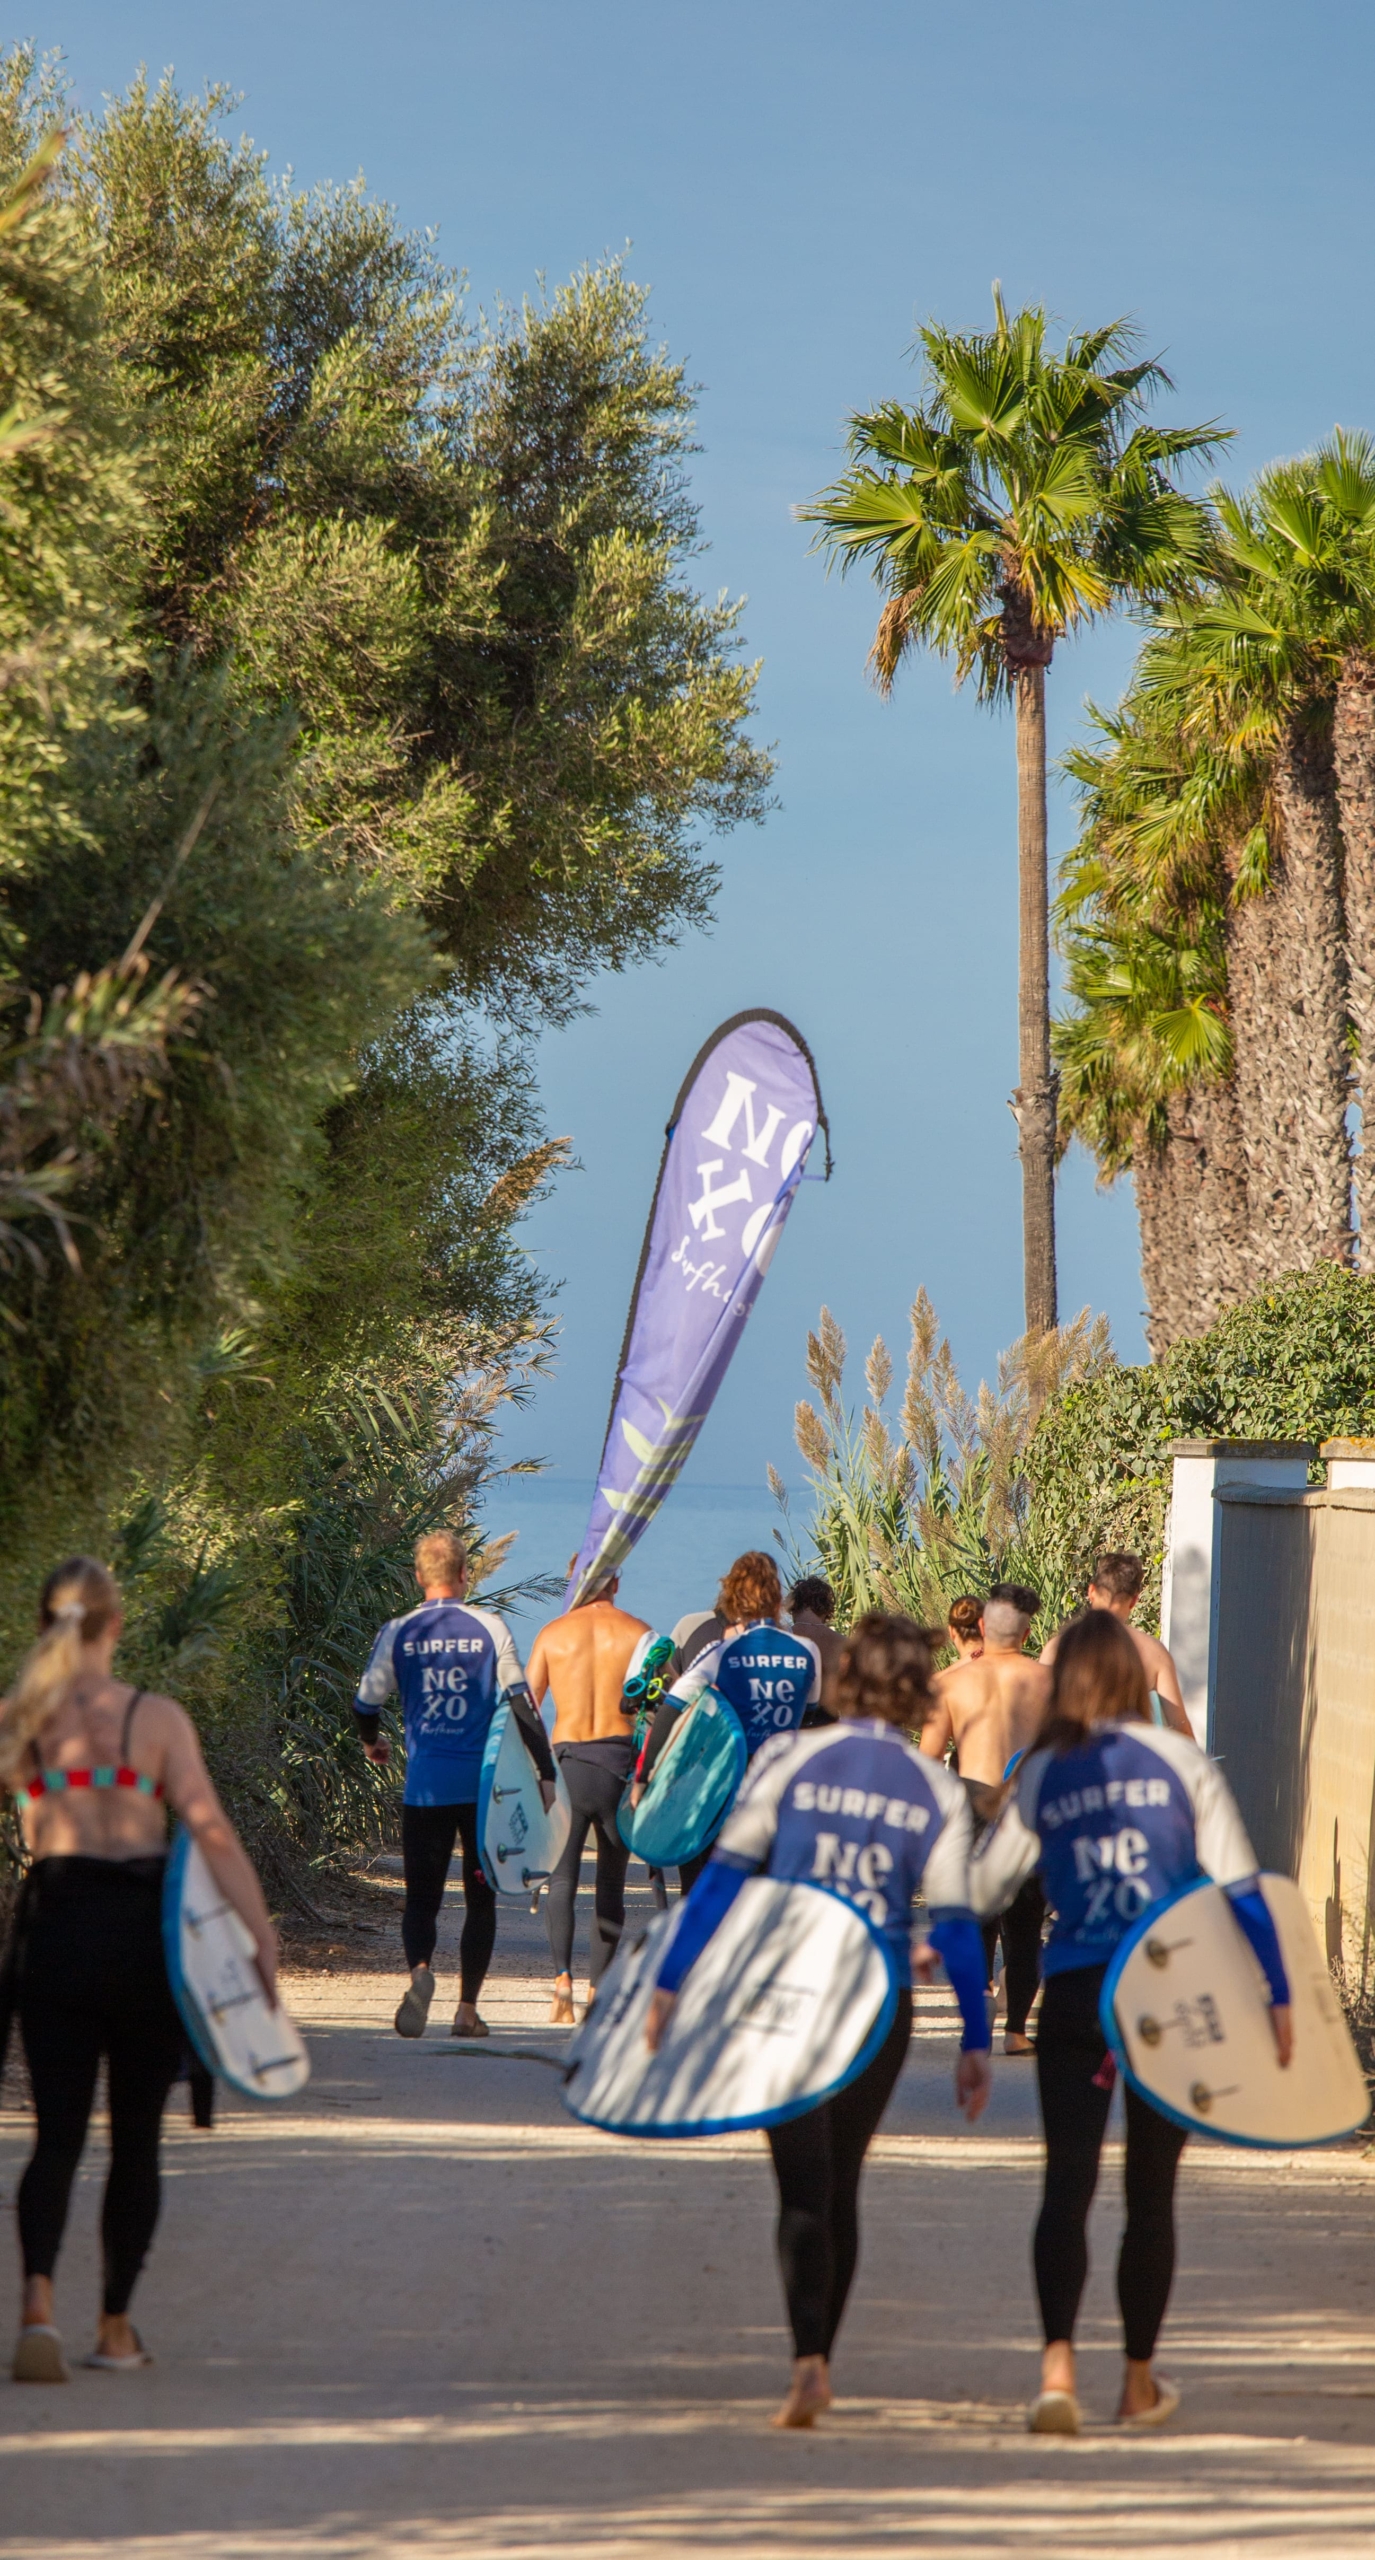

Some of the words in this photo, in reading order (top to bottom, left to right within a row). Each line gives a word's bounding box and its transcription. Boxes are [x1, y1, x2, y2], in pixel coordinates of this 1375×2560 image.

[403, 1638, 484, 1657] SURFER
[728, 1655, 808, 1670] SURFER
[421, 1666, 468, 1693] Ne
[748, 1678, 795, 1703] Ne
[792, 1781, 931, 1834] SURFER
[1040, 1778, 1171, 1830] SURFER
